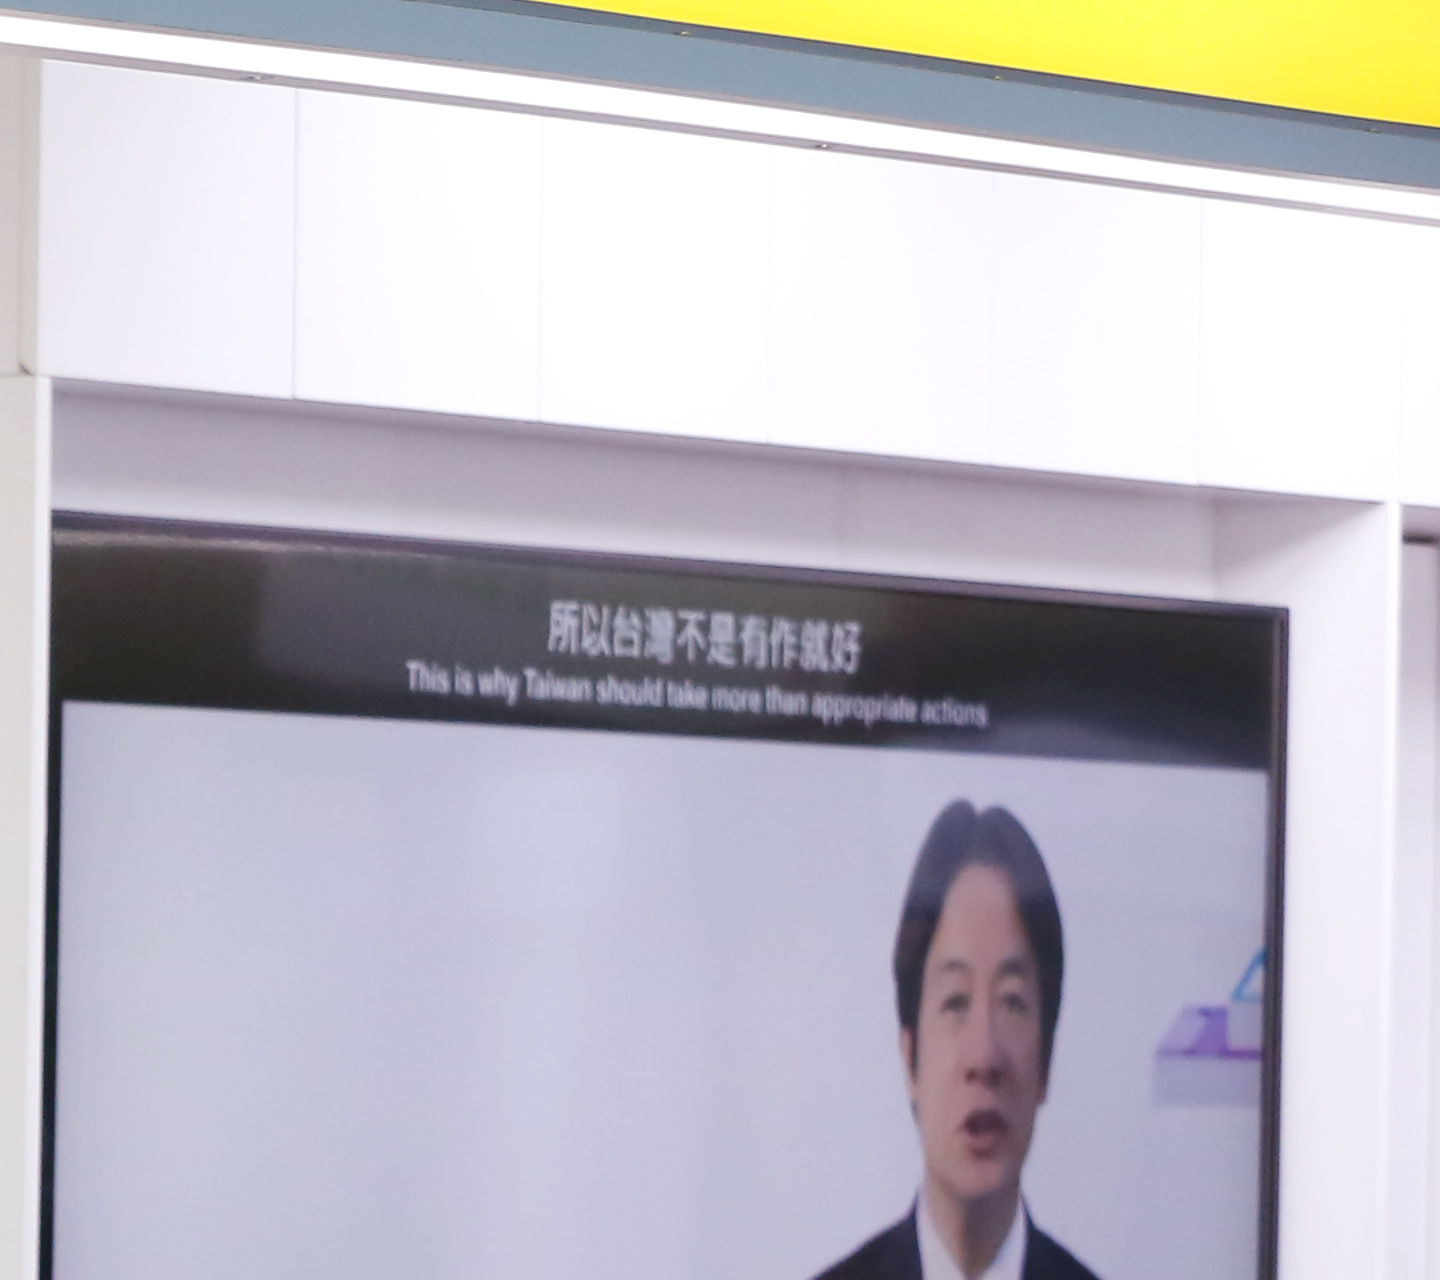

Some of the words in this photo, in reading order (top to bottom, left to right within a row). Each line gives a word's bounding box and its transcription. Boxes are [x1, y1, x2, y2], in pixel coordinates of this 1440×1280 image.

[406, 659, 451, 695] This
[454, 663, 474, 696] is
[477, 666, 520, 707] why
[524, 667, 593, 702] Taiwan
[596, 674, 665, 708] should
[667, 679, 708, 711] take
[711, 685, 762, 714] more
[765, 684, 809, 716] than
[811, 693, 918, 728] appropriate
[920, 697, 989, 727] actions
